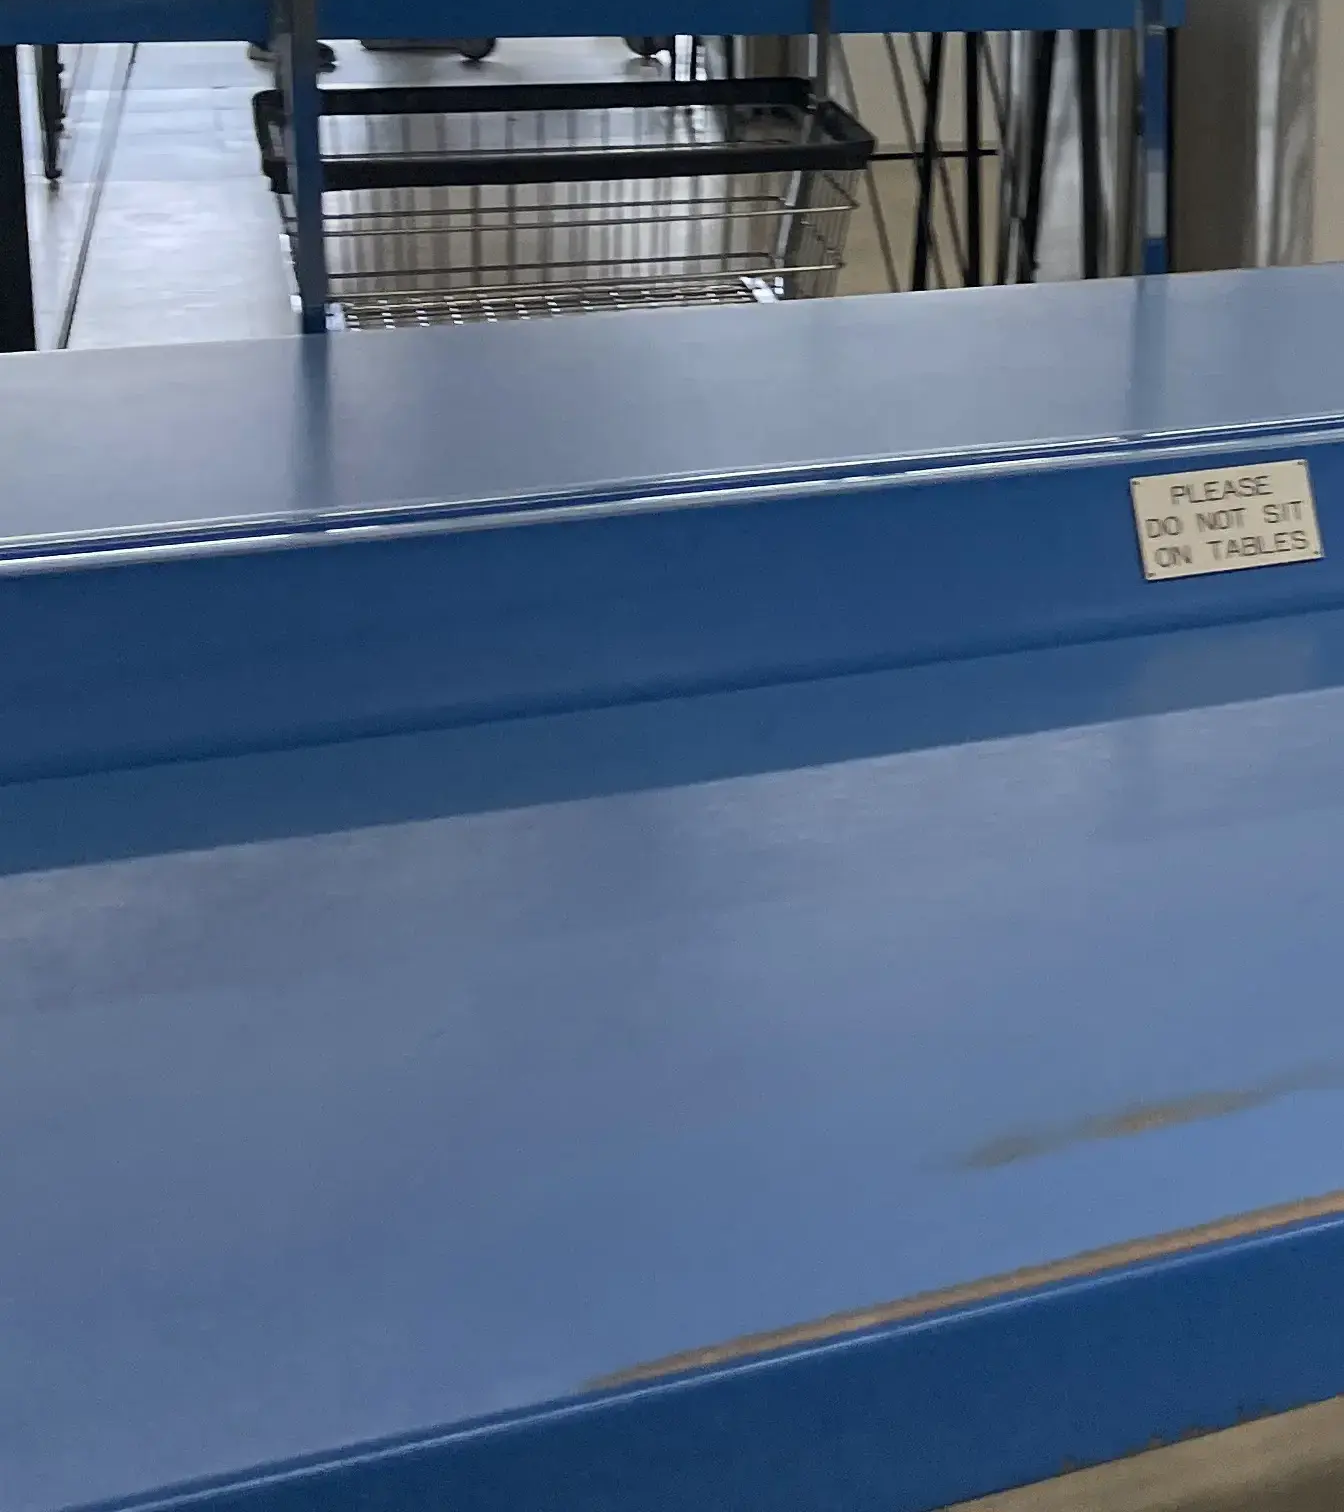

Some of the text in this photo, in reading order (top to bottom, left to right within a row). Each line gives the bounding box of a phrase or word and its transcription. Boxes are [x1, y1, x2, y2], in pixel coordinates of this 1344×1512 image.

[1170, 475, 1274, 505] PLEASE
[1145, 500, 1304, 538] DO NOT SIT
[1154, 530, 1310, 568] ON TABLES
